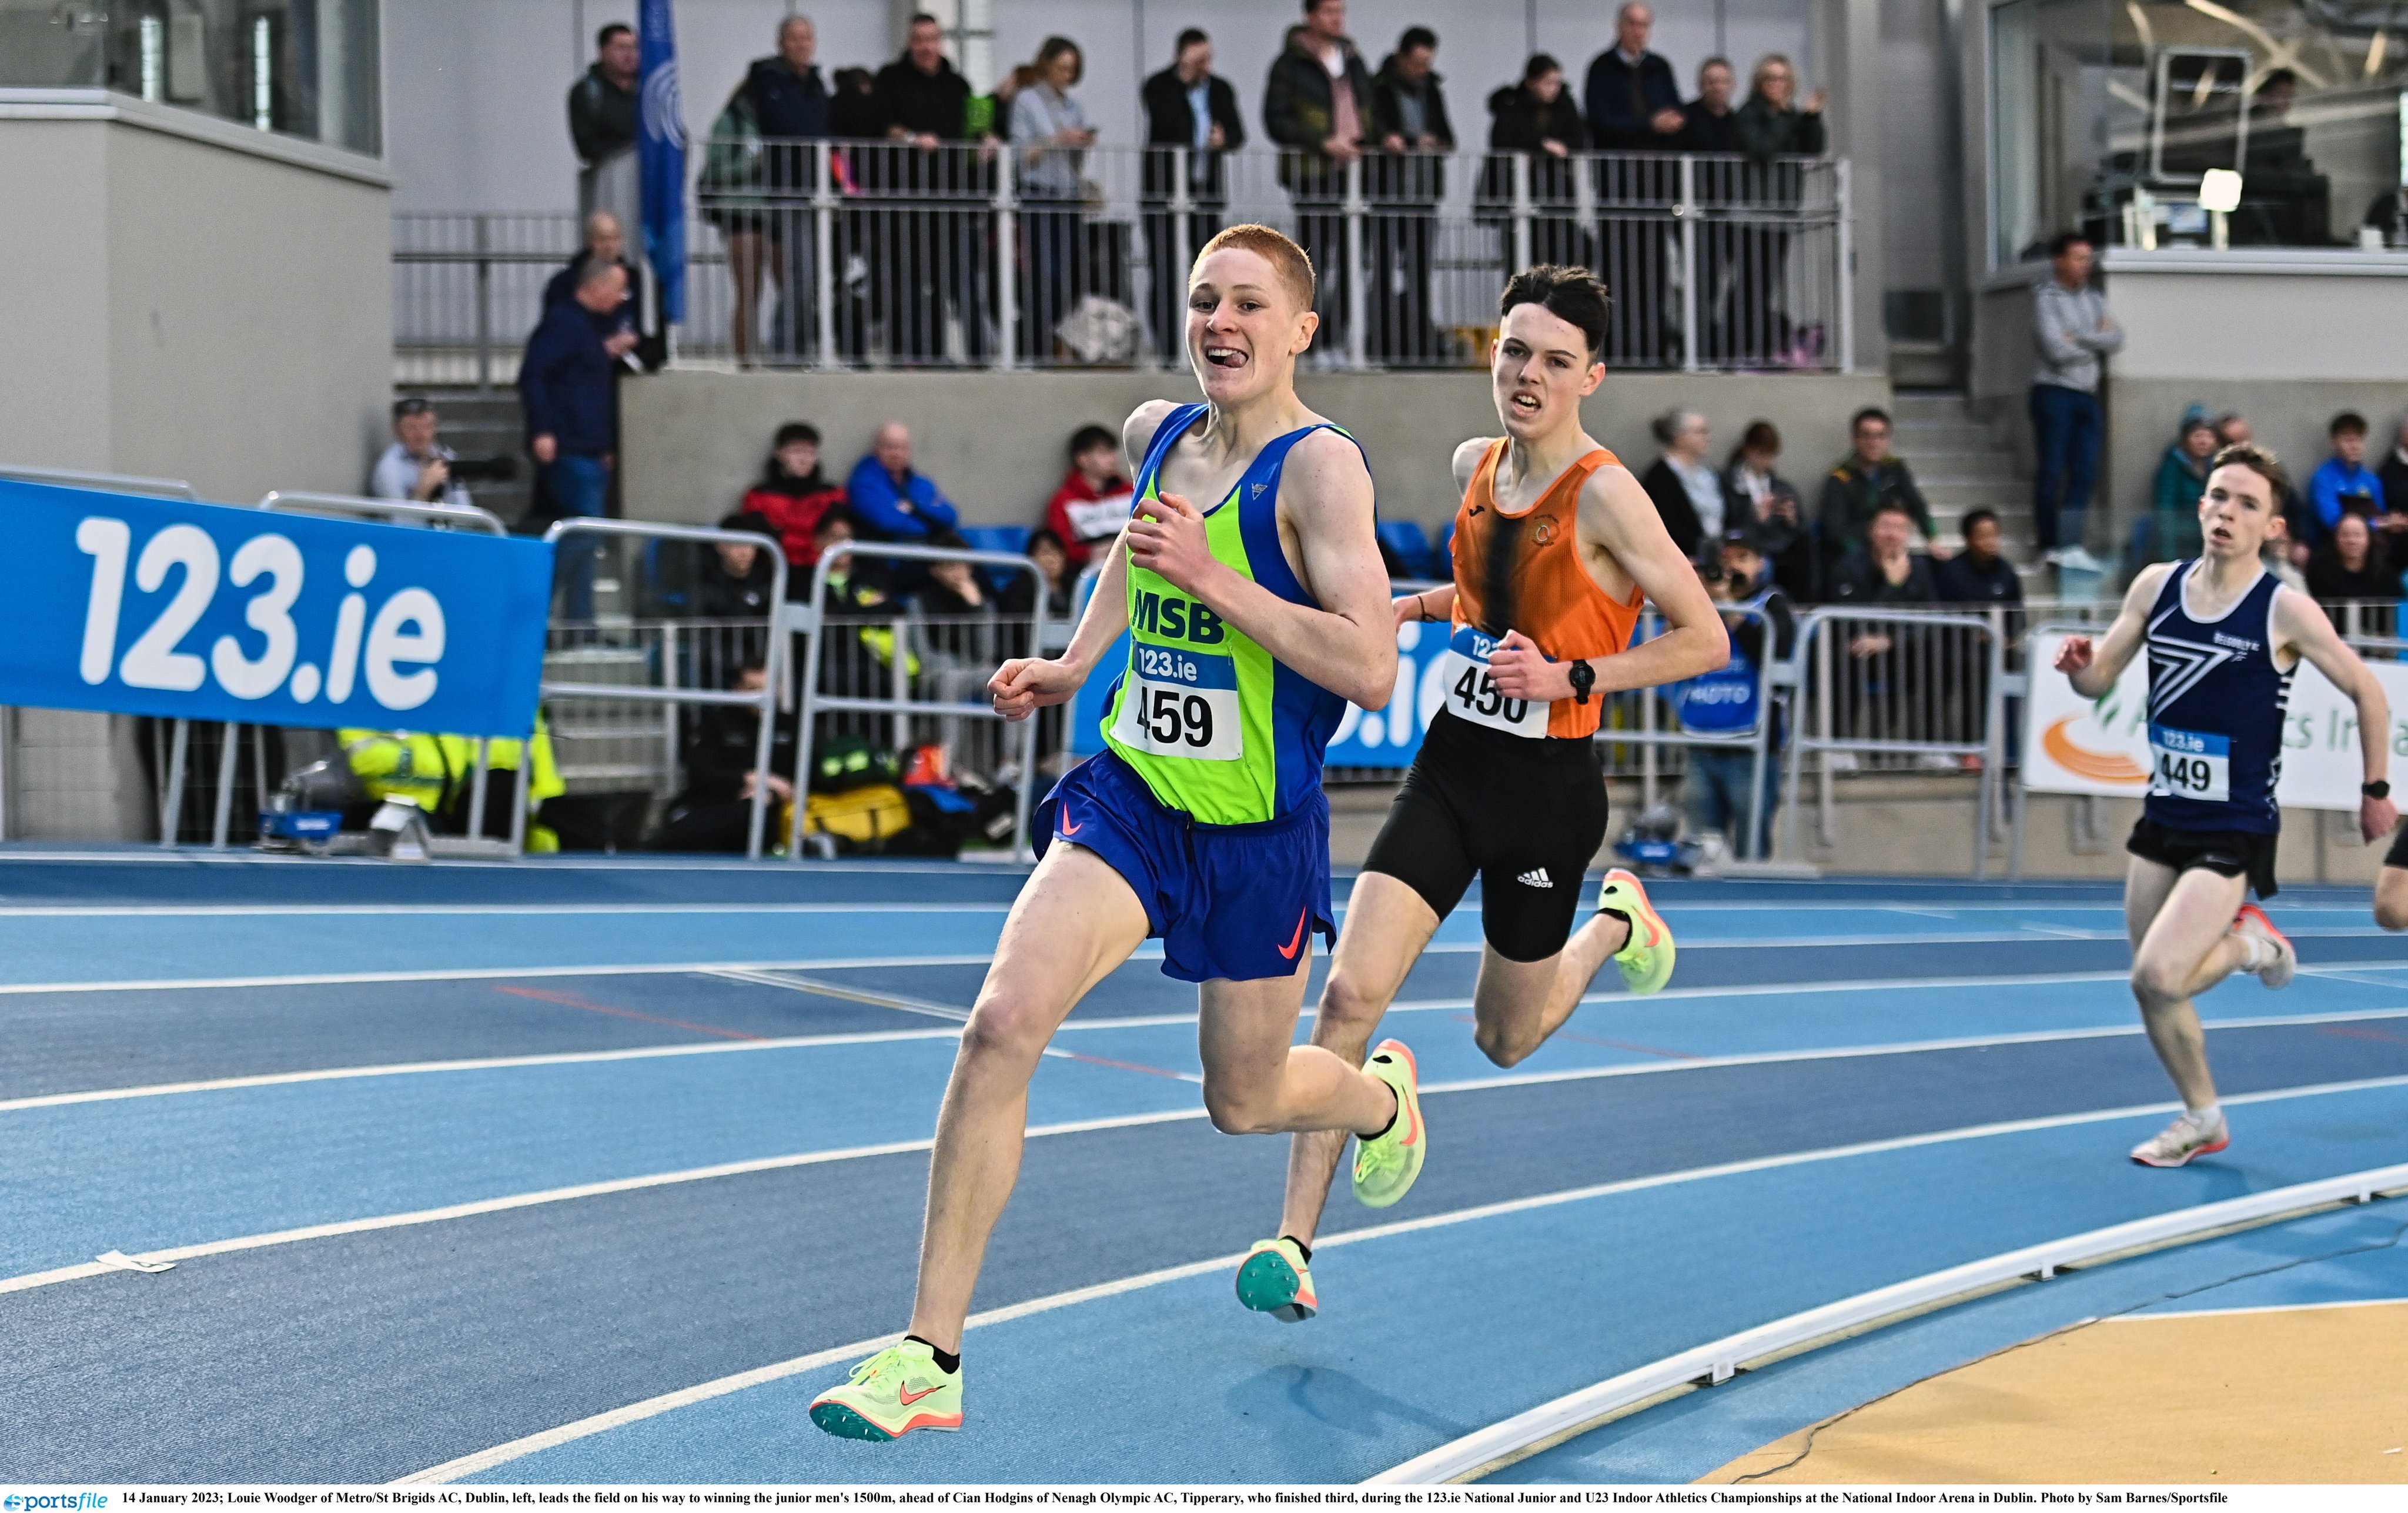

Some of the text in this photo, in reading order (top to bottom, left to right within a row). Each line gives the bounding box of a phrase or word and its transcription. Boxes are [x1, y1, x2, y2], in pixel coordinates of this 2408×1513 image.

[75, 516, 446, 710] 123.ie
[1132, 587, 1224, 644] MSB
[1139, 648, 1197, 682] 123.ie
[1136, 686, 1213, 747] 459
[1517, 876, 1553, 889] adidas
